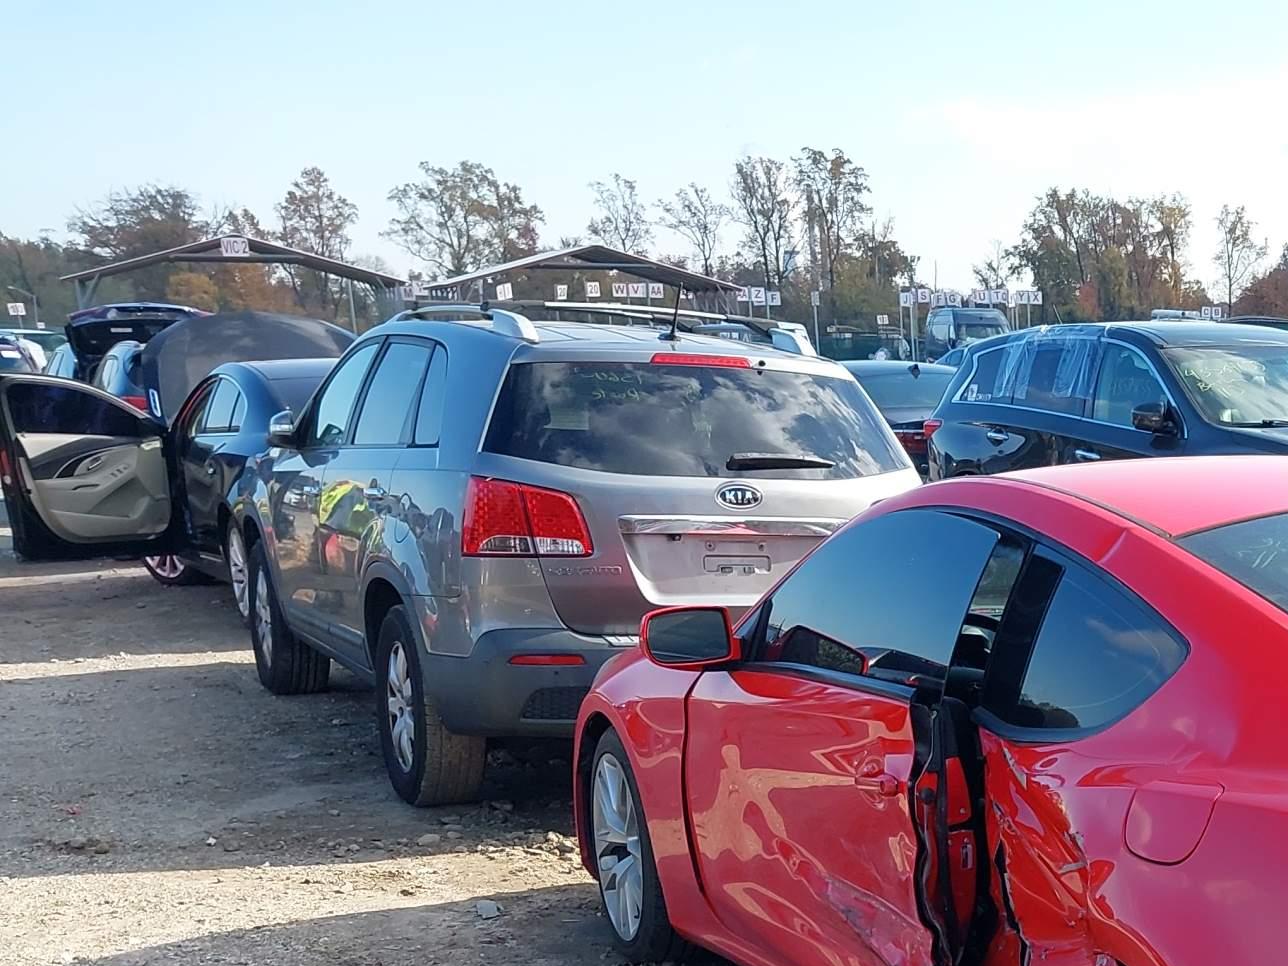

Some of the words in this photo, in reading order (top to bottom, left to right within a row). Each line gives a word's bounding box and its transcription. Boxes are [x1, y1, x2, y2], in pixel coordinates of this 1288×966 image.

[224, 238, 240, 254] VIC
[241, 239, 249, 253] 2
[614, 285, 626, 295] W
[632, 285, 640, 295] V
[651, 286, 662, 296] AA
[753, 289, 763, 299] Z
[770, 293, 777, 303] F
[920, 291, 927, 301] S
[937, 296, 943, 304] F
[949, 295, 956, 303] G
[978, 292, 986, 302] U
[992, 291, 1000, 301] T
[1018, 292, 1025, 302] Y
[1032, 292, 1040, 302] X
[725, 490, 756, 504] KIA
